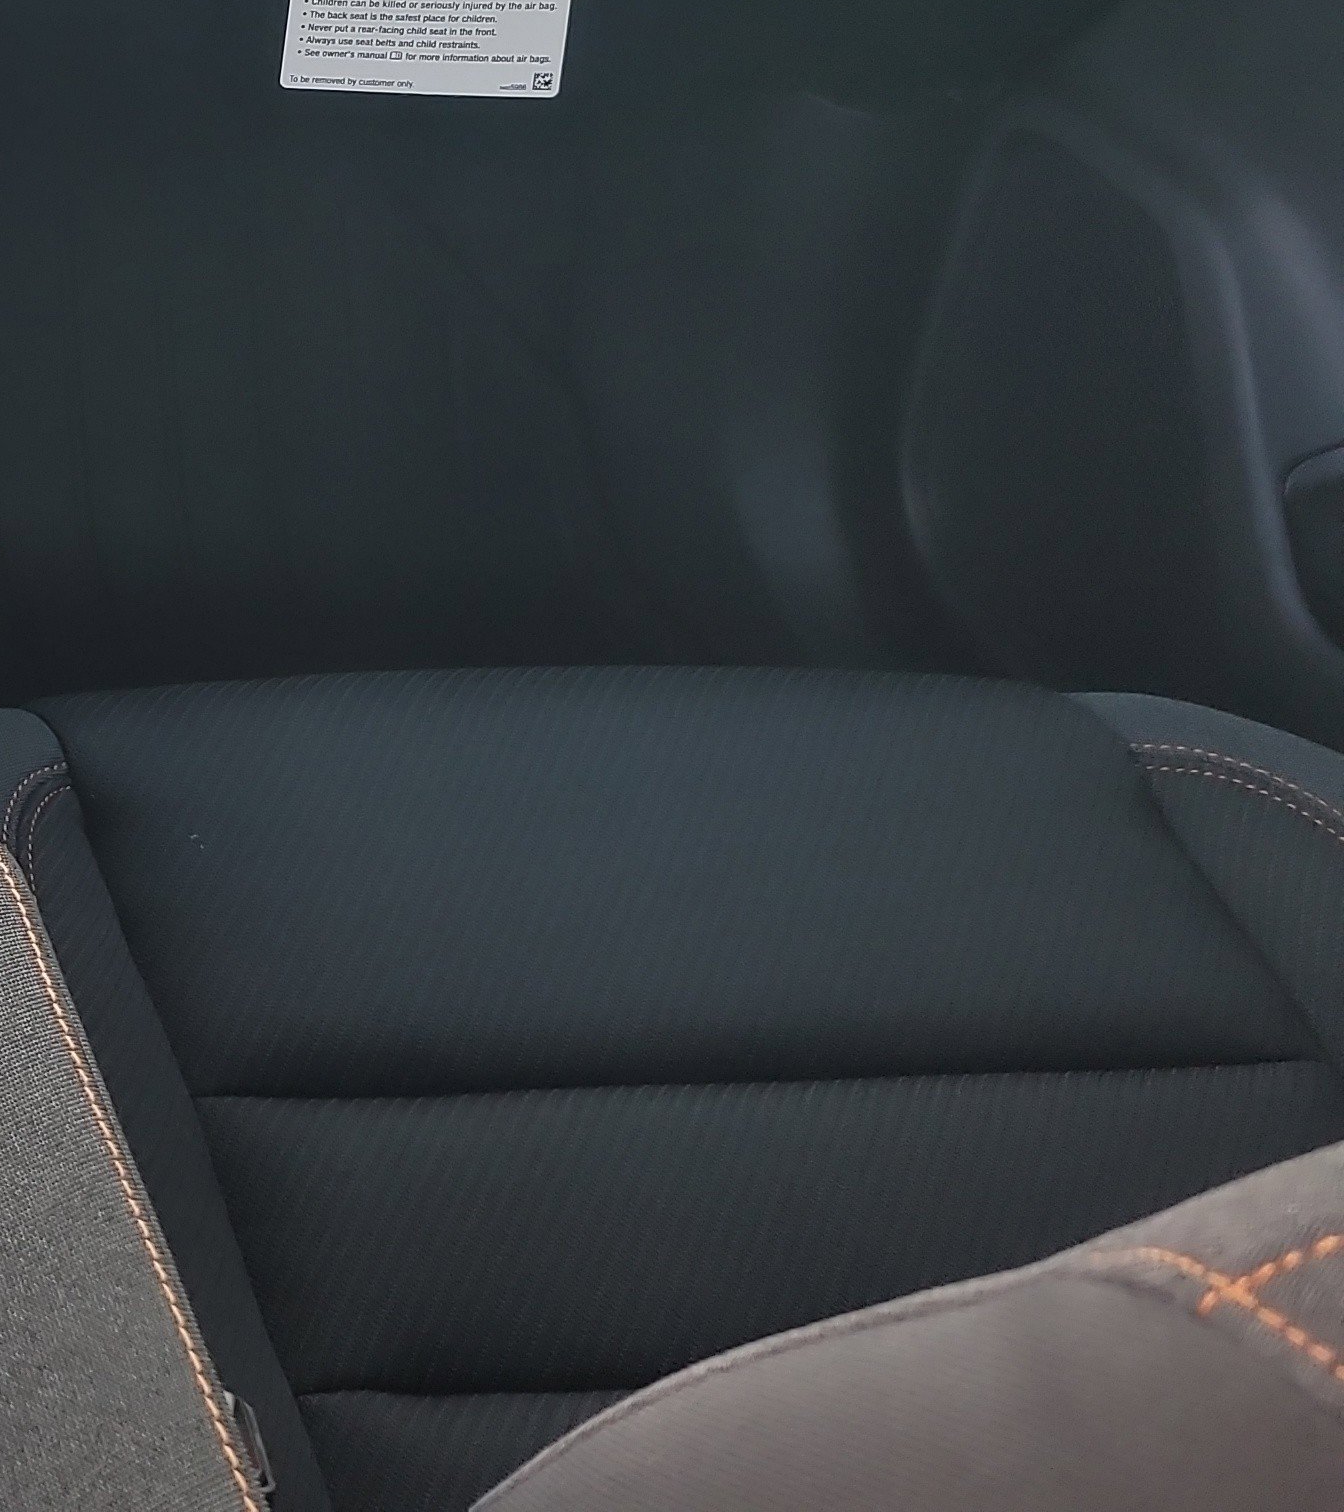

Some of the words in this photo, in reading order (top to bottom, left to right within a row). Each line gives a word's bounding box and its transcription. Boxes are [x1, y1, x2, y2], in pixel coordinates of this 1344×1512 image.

[370, 0, 380, 8] be
[383, 0, 406, 8] killed
[421, 1, 460, 11] seriously
[462, 2, 493, 11] injured
[495, 2, 506, 11] by
[508, 2, 522, 10] the
[525, 2, 536, 10] air
[539, 2, 558, 11] bag.
[310, 10, 325, 19] The
[327, 11, 347, 19] back
[380, 13, 393, 21] the
[423, 14, 445, 23] place
[462, 15, 497, 23] children.
[308, 24, 332, 32] Never
[334, 25, 348, 33] put
[358, 26, 404, 35] rear-facing
[407, 27, 427, 35] child
[475, 28, 497, 36] front.
[306, 36, 336, 45] Always
[356, 38, 373, 46] seat
[375, 39, 396, 47] belts
[416, 40, 436, 48] child
[439, 41, 480, 49] restraints.
[304, 49, 320, 57] See
[322, 50, 354, 58] owner's
[357, 51, 387, 59] manual
[405, 52, 416, 60] for
[419, 53, 440, 61] more
[442, 54, 489, 62] information
[491, 54, 514, 63] about
[516, 55, 527, 63] air
[529, 55, 551, 64] bags.
[290, 75, 298, 83] To
[312, 77, 346, 85] removed
[348, 78, 357, 86] by
[358, 79, 395, 87] customer
[397, 80, 414, 88] only.
